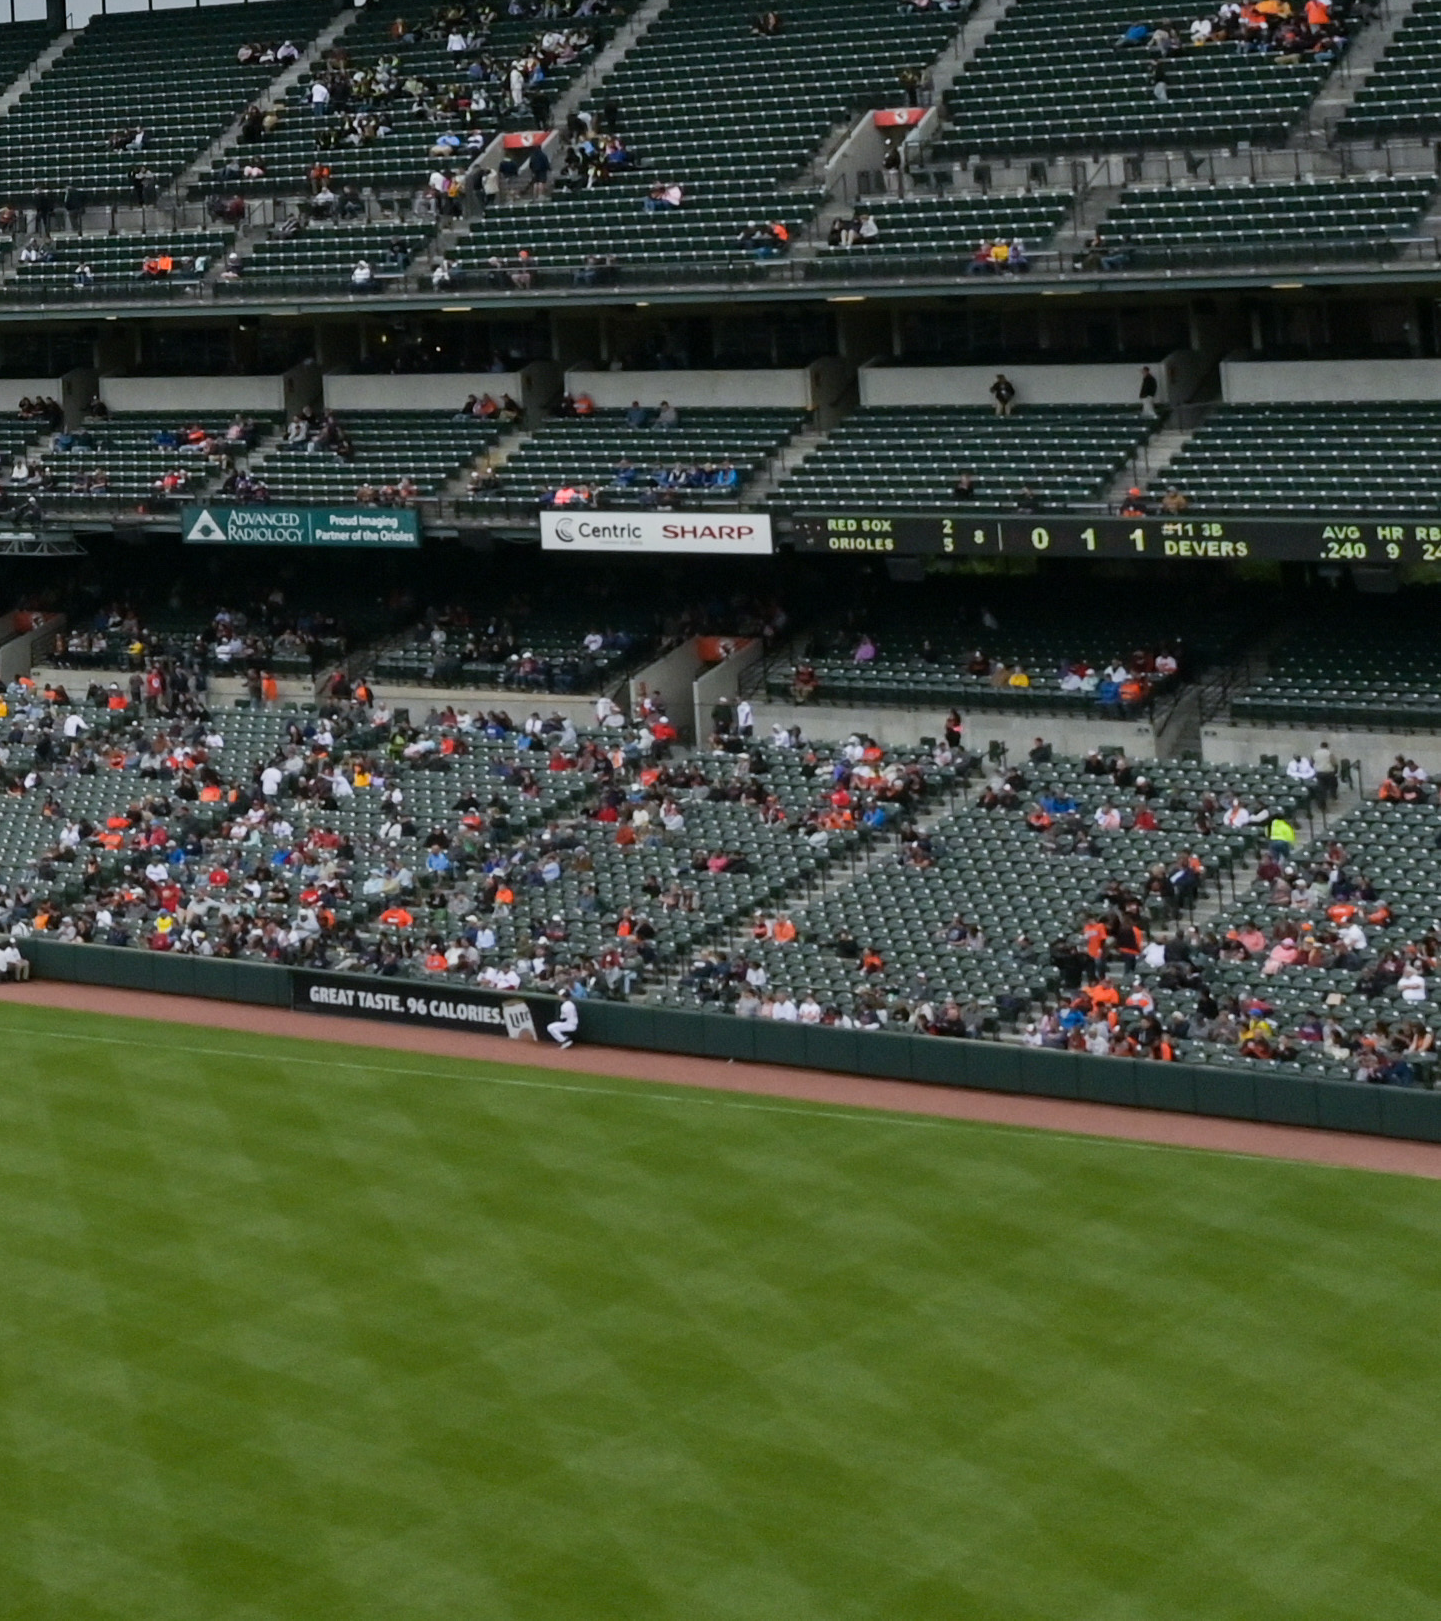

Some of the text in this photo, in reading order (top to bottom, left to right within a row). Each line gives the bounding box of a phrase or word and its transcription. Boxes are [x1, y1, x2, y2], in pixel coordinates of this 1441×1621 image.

[228, 510, 300, 526] ADVANCED
[330, 515, 398, 529] Proud Imaging
[228, 525, 304, 542] RADIOLOGY
[579, 522, 642, 539] Centric
[662, 525, 754, 540] SHARP
[828, 519, 953, 533] RED SOX 2
[1201, 524, 1223, 537] 3B
[1322, 526, 1360, 539] AVG
[1377, 527, 1404, 540] HR
[316, 529, 415, 542] Partner of the Orioles
[1031, 528, 1145, 551] 0 1 1
[828, 538, 954, 552] ORIOLES 5
[1164, 541, 1248, 557] DEVERS
[1320, 542, 1366, 559] .240
[1386, 543, 1399, 559] 9
[310, 986, 506, 1024] GREAT TASTE. 96 CALORIES.
